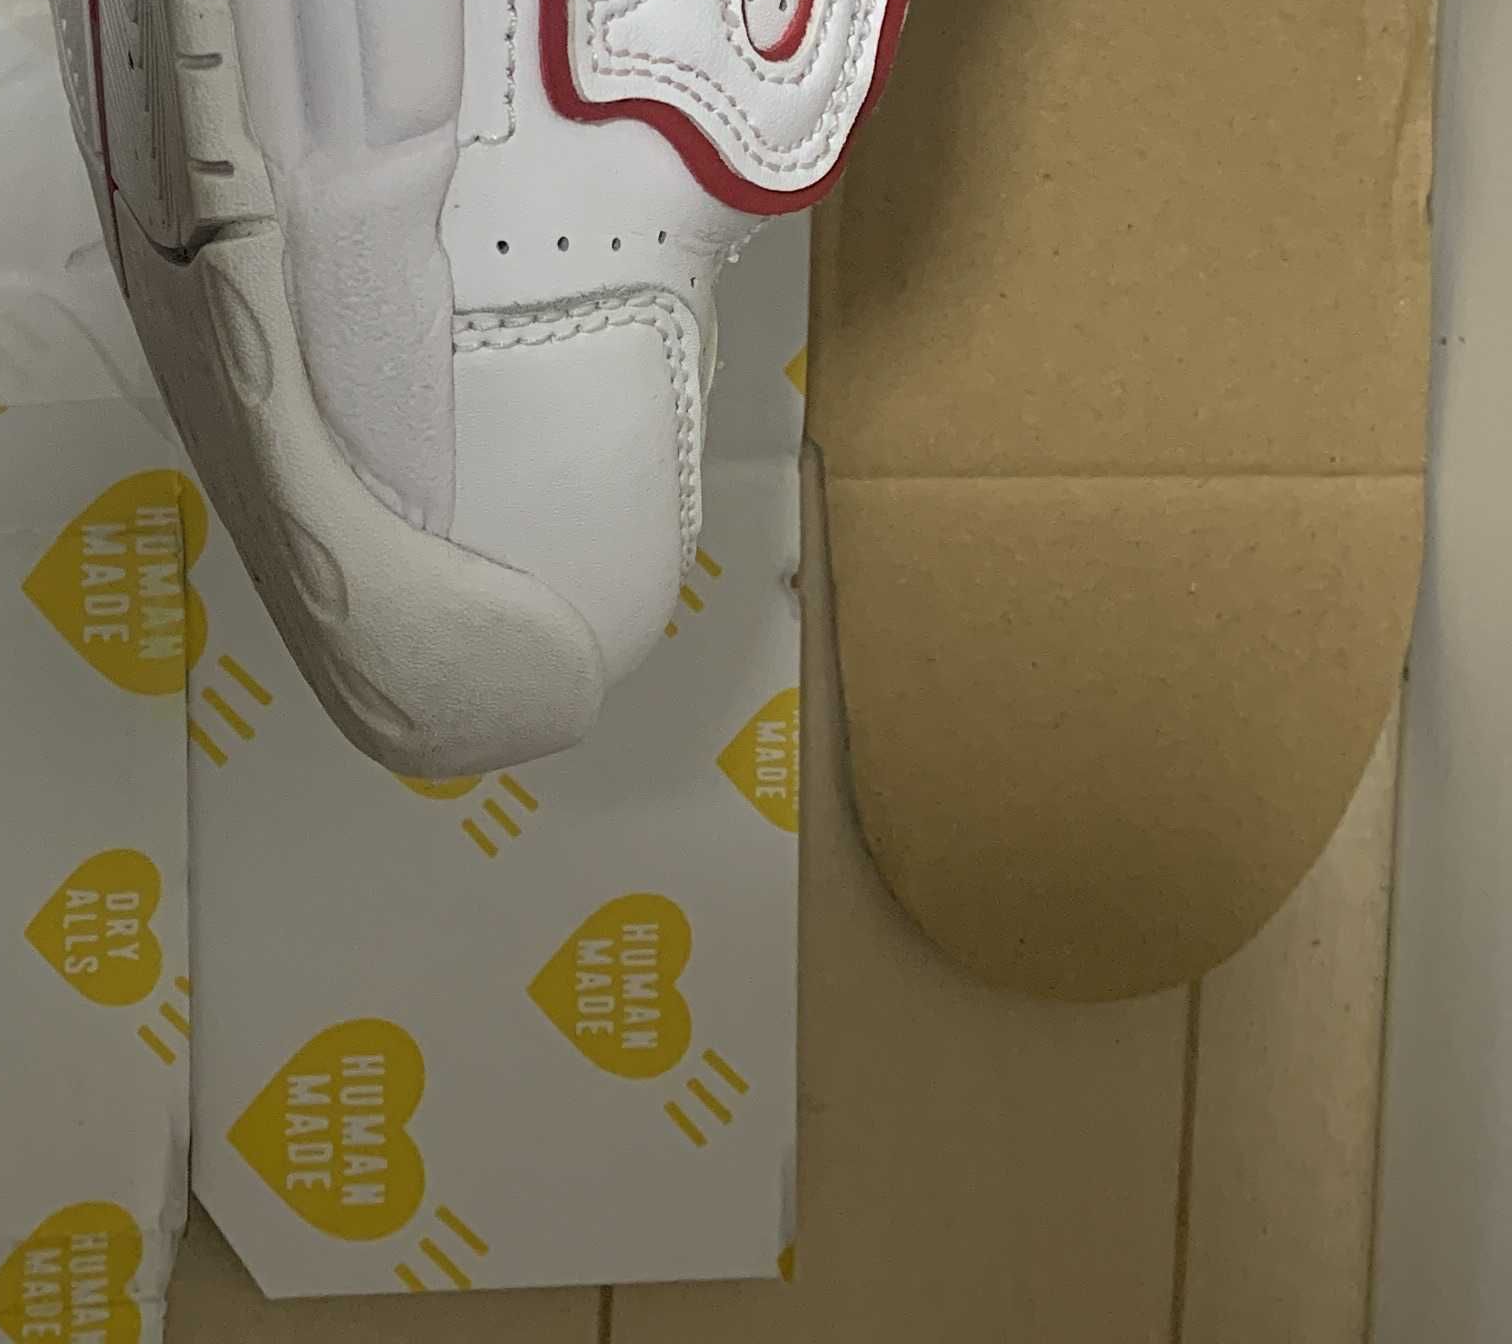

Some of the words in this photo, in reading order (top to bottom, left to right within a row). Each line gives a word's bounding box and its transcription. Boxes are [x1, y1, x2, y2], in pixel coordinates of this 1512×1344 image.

[82, 523, 131, 641] MADE
[134, 506, 185, 660] HUMAN
[757, 720, 788, 795] MADE
[64, 887, 99, 977] ALLS
[104, 891, 141, 960] DRY
[576, 938, 615, 1032] MADE
[620, 922, 660, 1050] HUMAN
[285, 1074, 334, 1188] MADE
[339, 1055, 388, 1205] HUMAN
[22, 1248, 61, 1335] MADE
